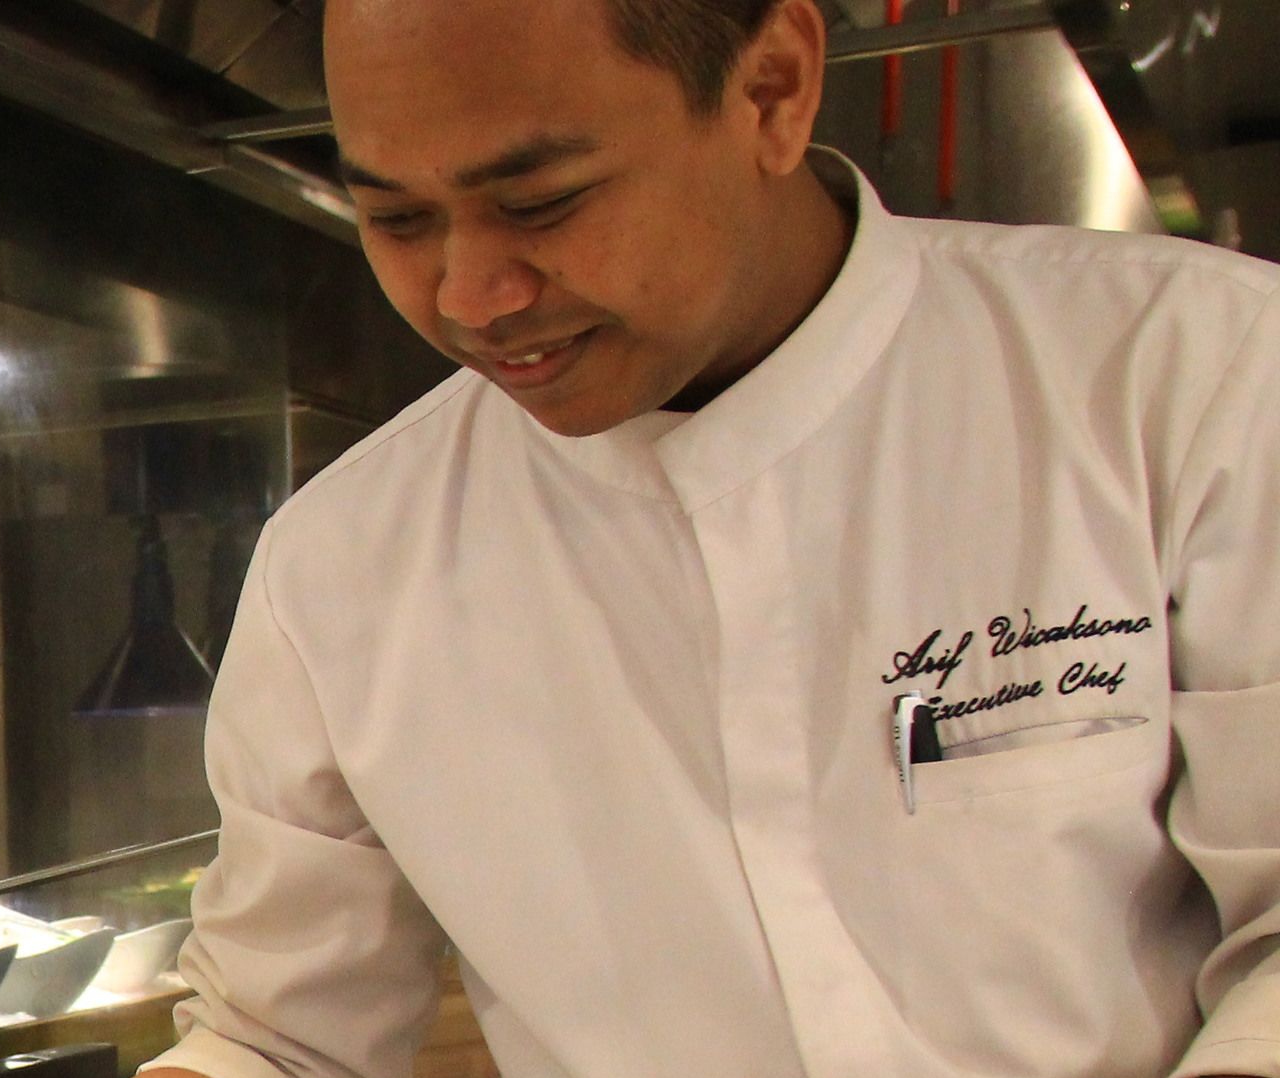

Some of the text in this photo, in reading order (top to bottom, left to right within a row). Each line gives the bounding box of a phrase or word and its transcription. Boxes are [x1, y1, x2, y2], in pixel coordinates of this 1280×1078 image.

[882, 604, 1152, 689] Arif Wicaksono
[1058, 662, 1126, 695] Chef
